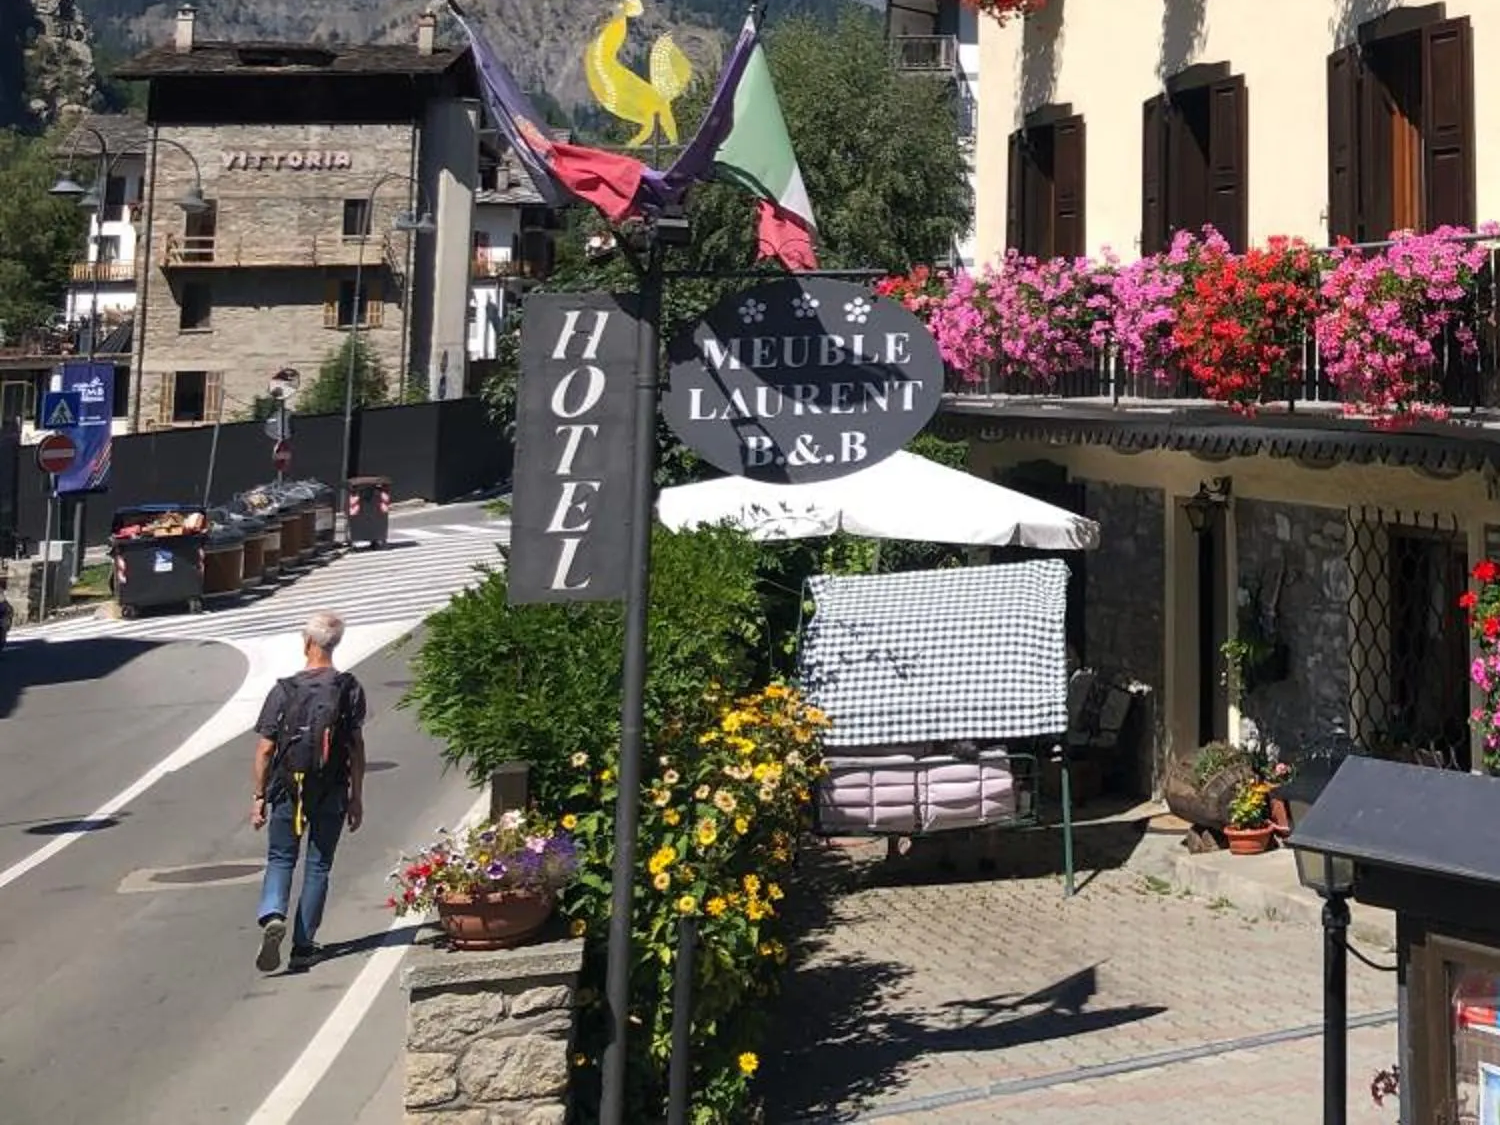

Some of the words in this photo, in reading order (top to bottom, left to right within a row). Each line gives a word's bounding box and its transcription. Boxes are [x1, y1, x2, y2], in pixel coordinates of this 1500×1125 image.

[221, 150, 352, 171] VITTORIA
[688, 379, 923, 421] LAURENT
[545, 310, 609, 591] HOTEL
